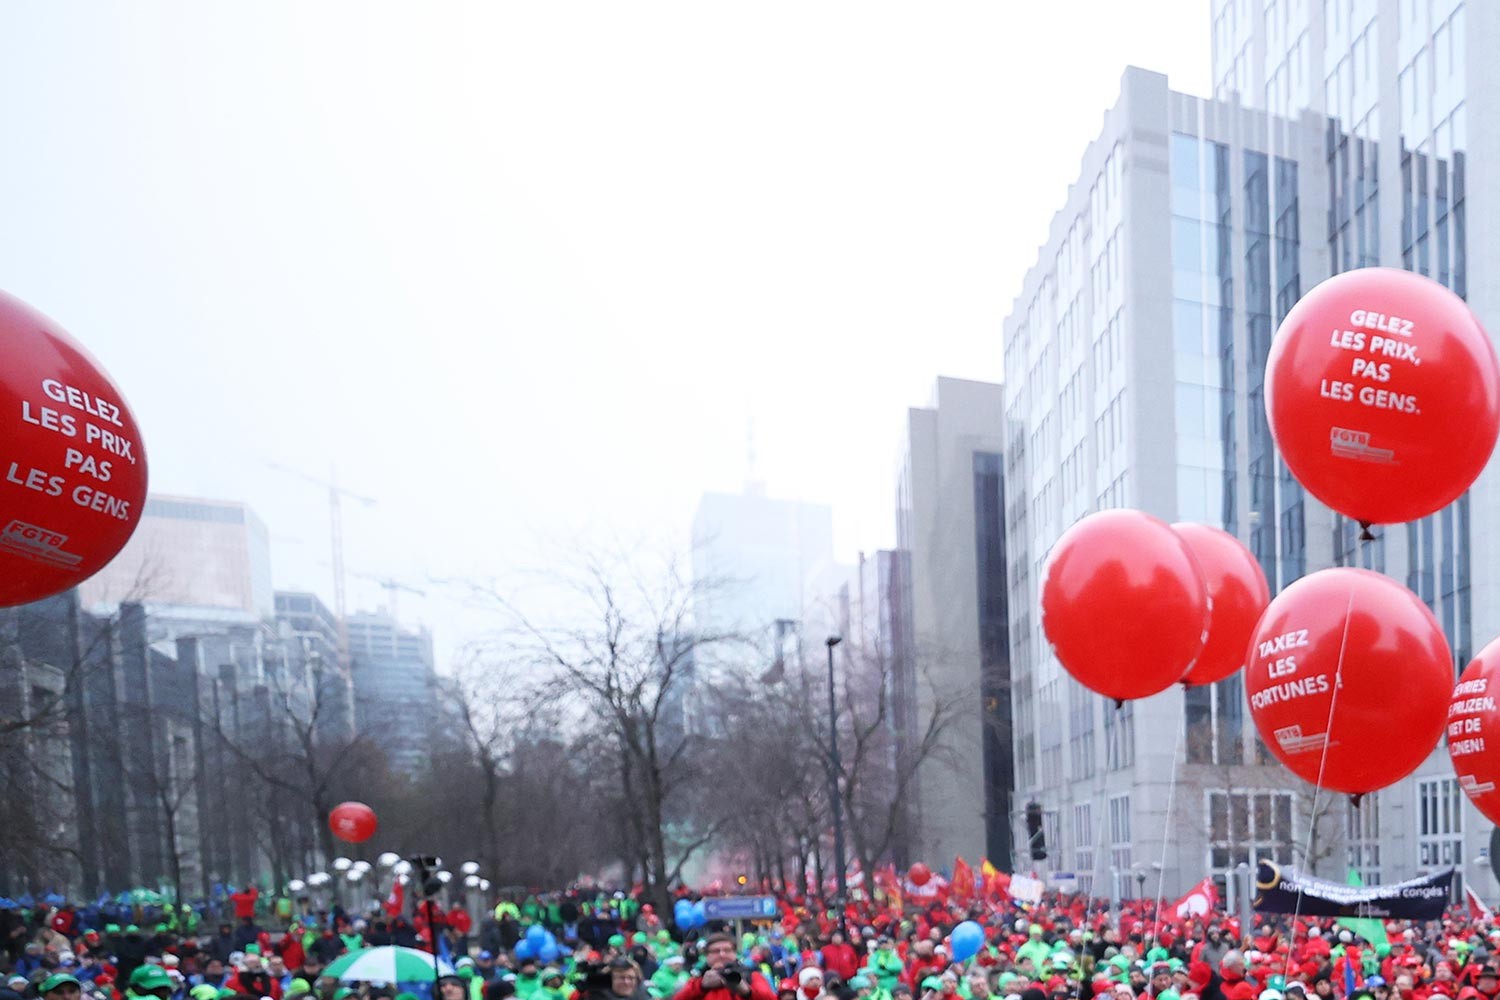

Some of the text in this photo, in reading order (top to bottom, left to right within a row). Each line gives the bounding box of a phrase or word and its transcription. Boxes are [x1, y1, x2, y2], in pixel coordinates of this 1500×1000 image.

[1350, 310, 1414, 336] GELEZ
[1330, 330, 1421, 366] LES PRIX,
[1352, 358, 1391, 382] PAS
[42, 378, 123, 427] GELEZ
[1320, 379, 1421, 414] LES GENS.
[22, 400, 136, 465] LES PRIX,
[64, 448, 113, 482] PAS
[6, 462, 130, 520] LES GENS.
[8, 523, 64, 547] FGTB
[1259, 628, 1309, 659] TAXEZ
[1268, 656, 1297, 679] LES
[1251, 674, 1330, 711] FORTUNES
[1465, 717, 1482, 734] DE
[1279, 880, 1301, 893] non
